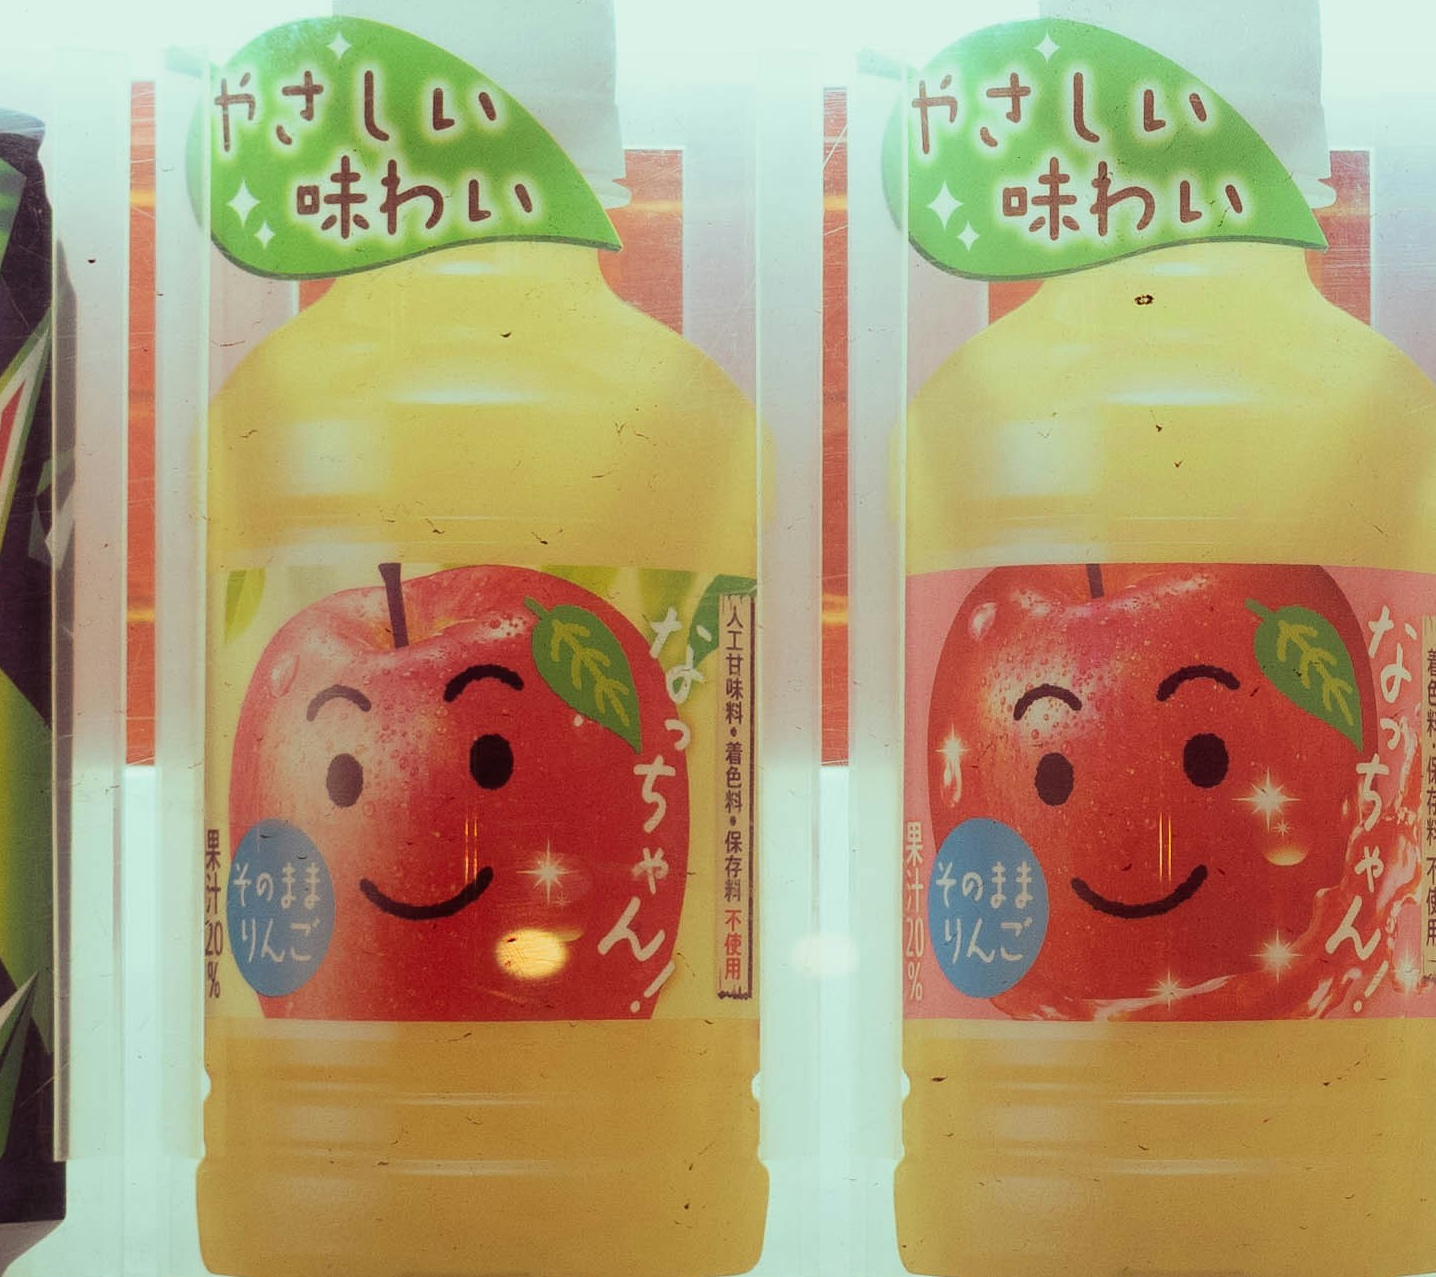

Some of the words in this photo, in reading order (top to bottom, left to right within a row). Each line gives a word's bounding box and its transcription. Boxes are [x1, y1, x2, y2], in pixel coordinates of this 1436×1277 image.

[215, 70, 496, 152] やさしい
[912, 73, 1208, 154] やさしい
[296, 156, 533, 239] 味わい
[1003, 157, 1244, 240] 味わい
[233, 862, 321, 909] そのまま
[936, 862, 1034, 909] そのまま
[241, 917, 321, 962] りんご
[942, 917, 1032, 963] りんご
